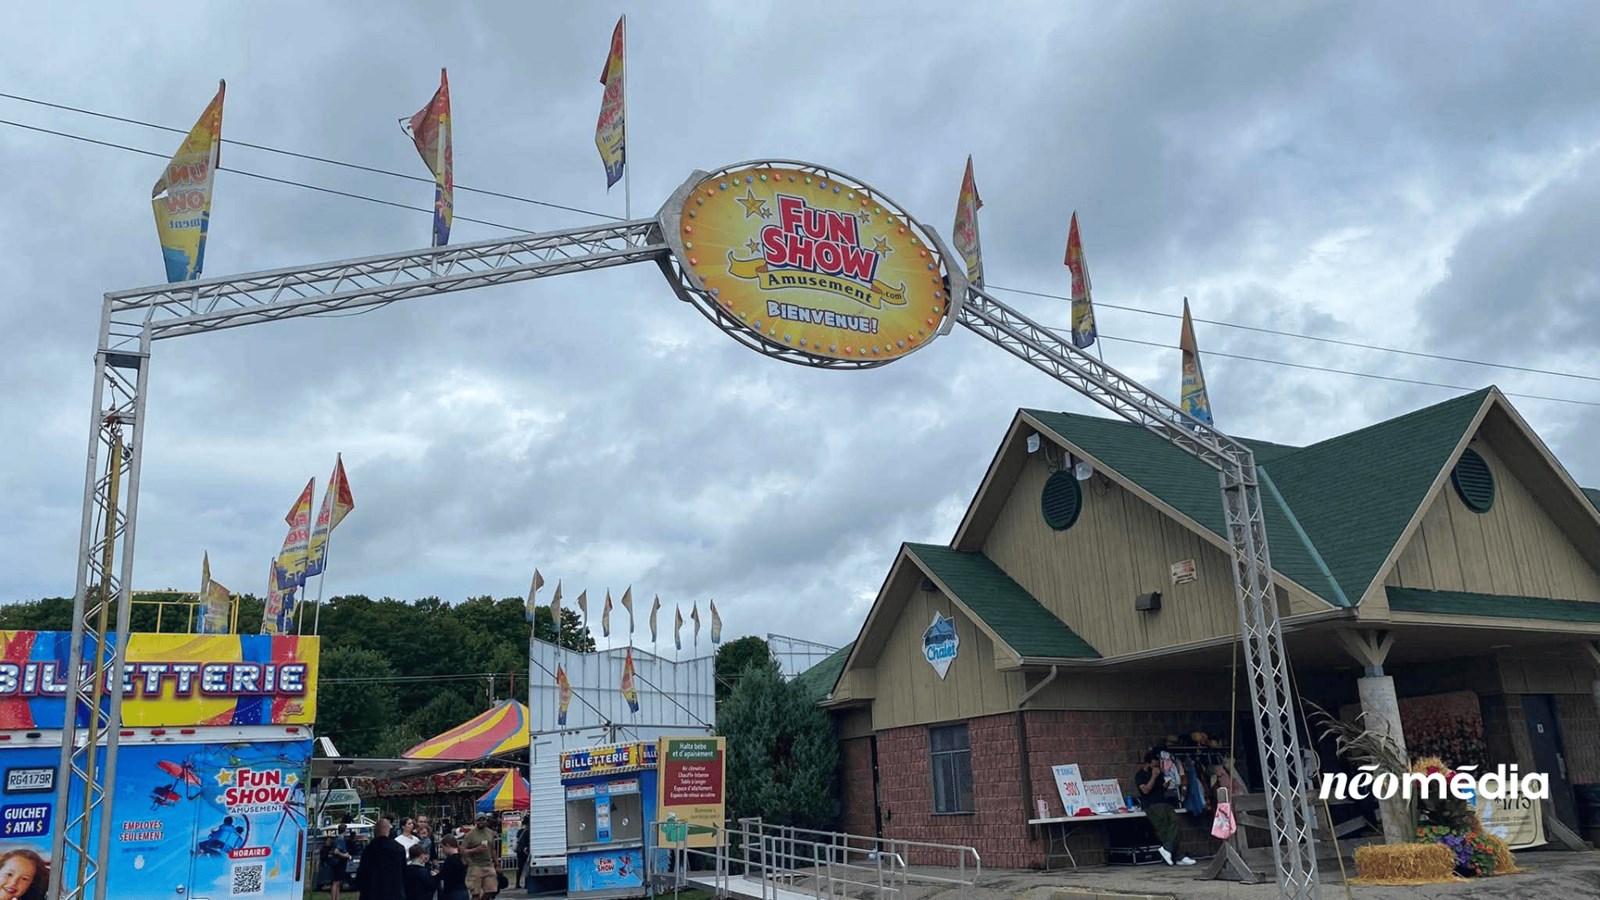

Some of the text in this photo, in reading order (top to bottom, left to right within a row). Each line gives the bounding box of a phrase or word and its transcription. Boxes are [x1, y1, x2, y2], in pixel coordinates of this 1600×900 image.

[777, 194, 859, 246] FUN
[761, 225, 879, 283] SHOW
[768, 273, 873, 303] Amusement
[766, 300, 879, 334] BIENVENUE!
[927, 640, 956, 661] Chalet
[565, 752, 629, 769] BILLETTERIE
[237, 768, 281, 788] FUN
[225, 787, 290, 807] SHOW
[4, 806, 48, 820] GUICHET
[231, 804, 283, 814] AMUSEMENT
[13, 821, 35, 833] ATM
[119, 831, 165, 842] SEULEMENT
[232, 849, 267, 858] HORAIRE
